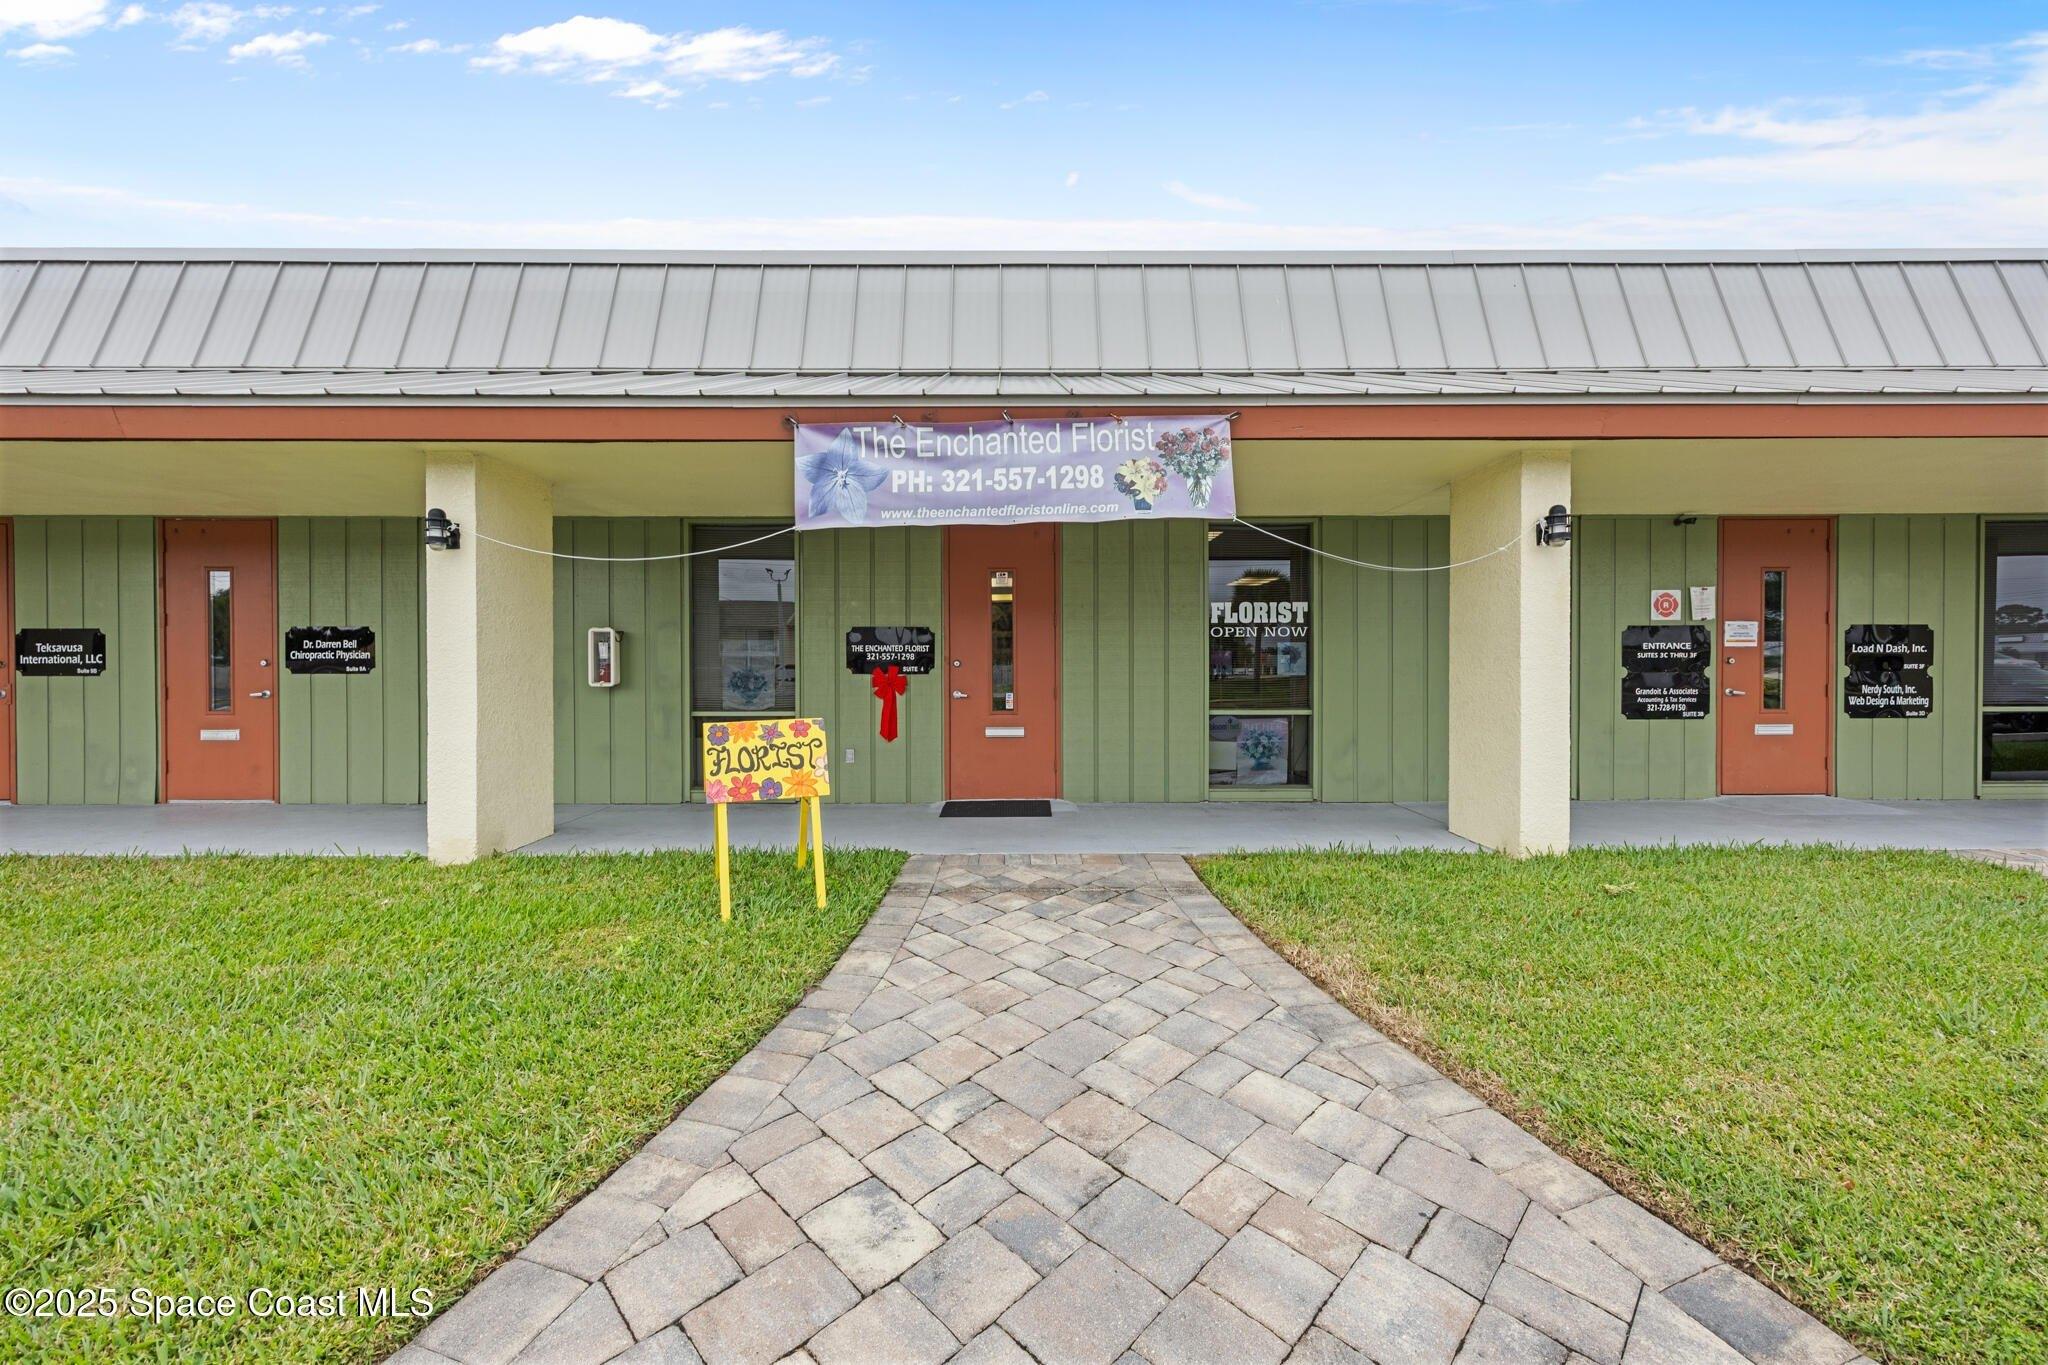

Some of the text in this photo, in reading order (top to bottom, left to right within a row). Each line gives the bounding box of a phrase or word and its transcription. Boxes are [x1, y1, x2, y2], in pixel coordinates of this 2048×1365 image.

[852, 421, 1155, 458] The Enchanted Florist
[891, 464, 1105, 493] PH: 321-557-1298
[880, 503, 1119, 520] www.theenchantedfloristonline.com
[1210, 601, 1309, 624] FLORIST
[1210, 626, 1308, 637] OPEN NOW
[35, 643, 83, 653] Teksavusa
[303, 640, 357, 649] Dr. Darren Bell
[1642, 642, 1692, 650] ENTRANCE
[1852, 644, 1928, 654] Load N Dash, Inc.
[20, 654, 103, 665] International, LLC
[290, 650, 371, 661] Chiropractic Physician
[1862, 684, 1917, 696] Nerdy South, Inc.
[1848, 696, 1930, 708] Web Design & Marketing
[1646, 704, 1686, 712] 321-728-9150
[706, 737, 823, 777] FLORIST
